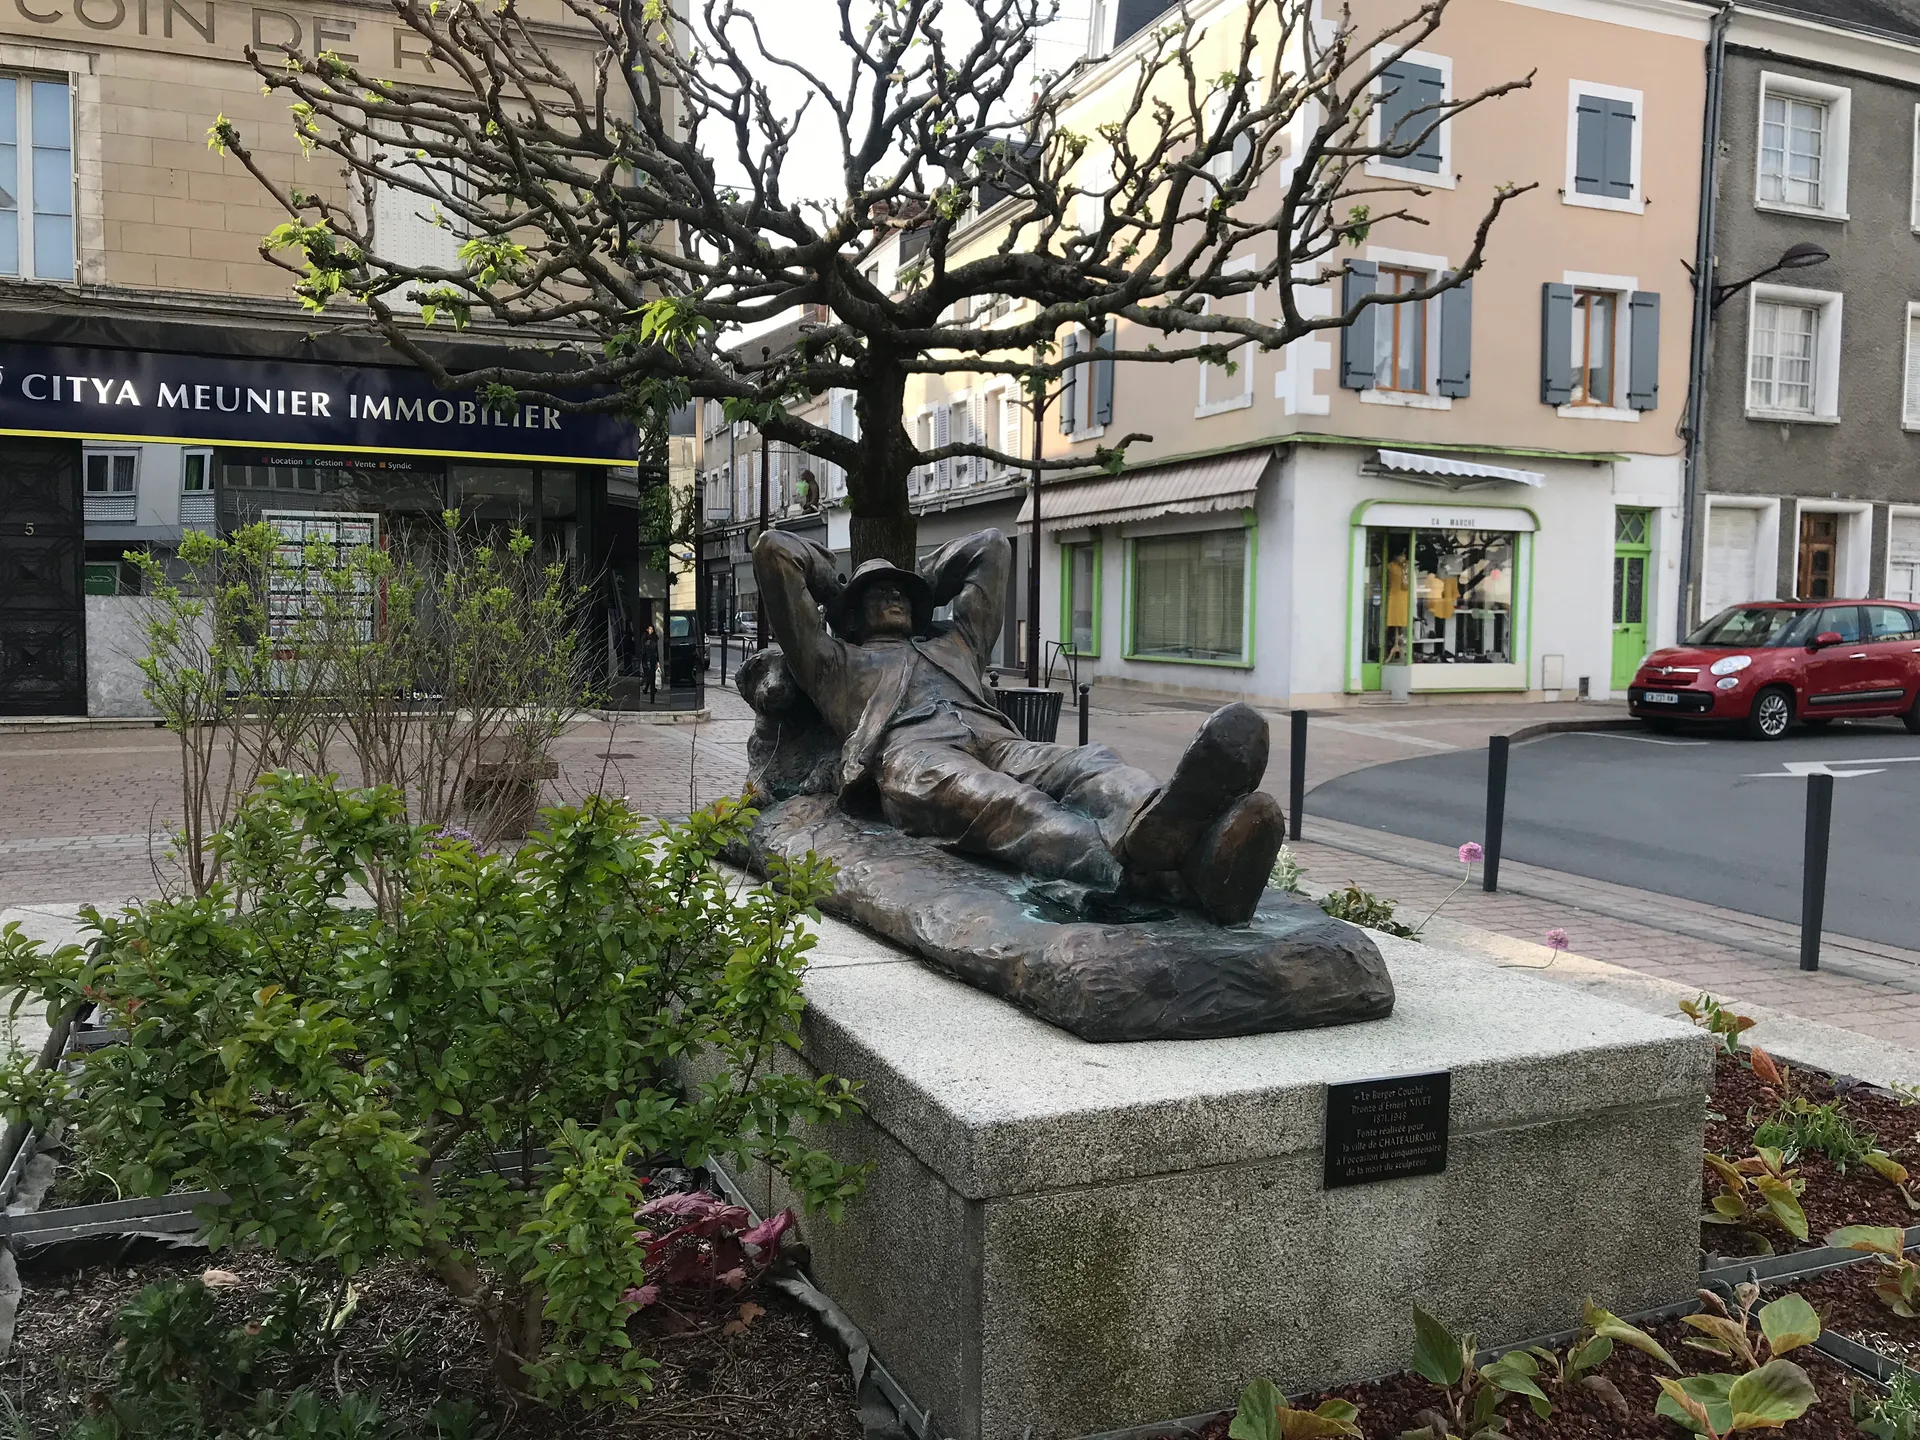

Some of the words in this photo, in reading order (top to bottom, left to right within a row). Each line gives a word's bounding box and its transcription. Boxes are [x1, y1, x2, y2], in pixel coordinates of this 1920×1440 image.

[252, 8, 359, 62] DE
[393, 27, 551, 86] RE
[21, 373, 141, 406] CITYA
[157, 382, 331, 418] MEUNIER
[270, 457, 303, 465] Location
[314, 458, 343, 467] Gestion
[354, 460, 376, 469] Vente
[388, 462, 412, 471] Syndic
[24, 522, 34, 536] 5
[1361, 1091, 1370, 1101] Le
[1372, 1090, 1395, 1100] Berger
[1397, 1085, 1424, 1097] Couché
[1351, 1104, 1377, 1115] Bronze
[1410, 1096, 1432, 1106] NIVET
[1356, 1128, 1378, 1138] Fonte
[1408, 1123, 1424, 1134] pour
[1342, 1142, 1350, 1152] la
[1351, 1142, 1366, 1151] ville
[1368, 1140, 1377, 1149] de
[1378, 1131, 1437, 1148] CHATEAUROUX
[1380, 1150, 1389, 1160] du
[1390, 1144, 1442, 1159] cinquantenaire
[1346, 1167, 1355, 1177] de
[1357, 1166, 1364, 1175] la
[1365, 1164, 1382, 1174] mort
[1384, 1162, 1393, 1171] du
[1395, 1158, 1427, 1170] sculpteur
